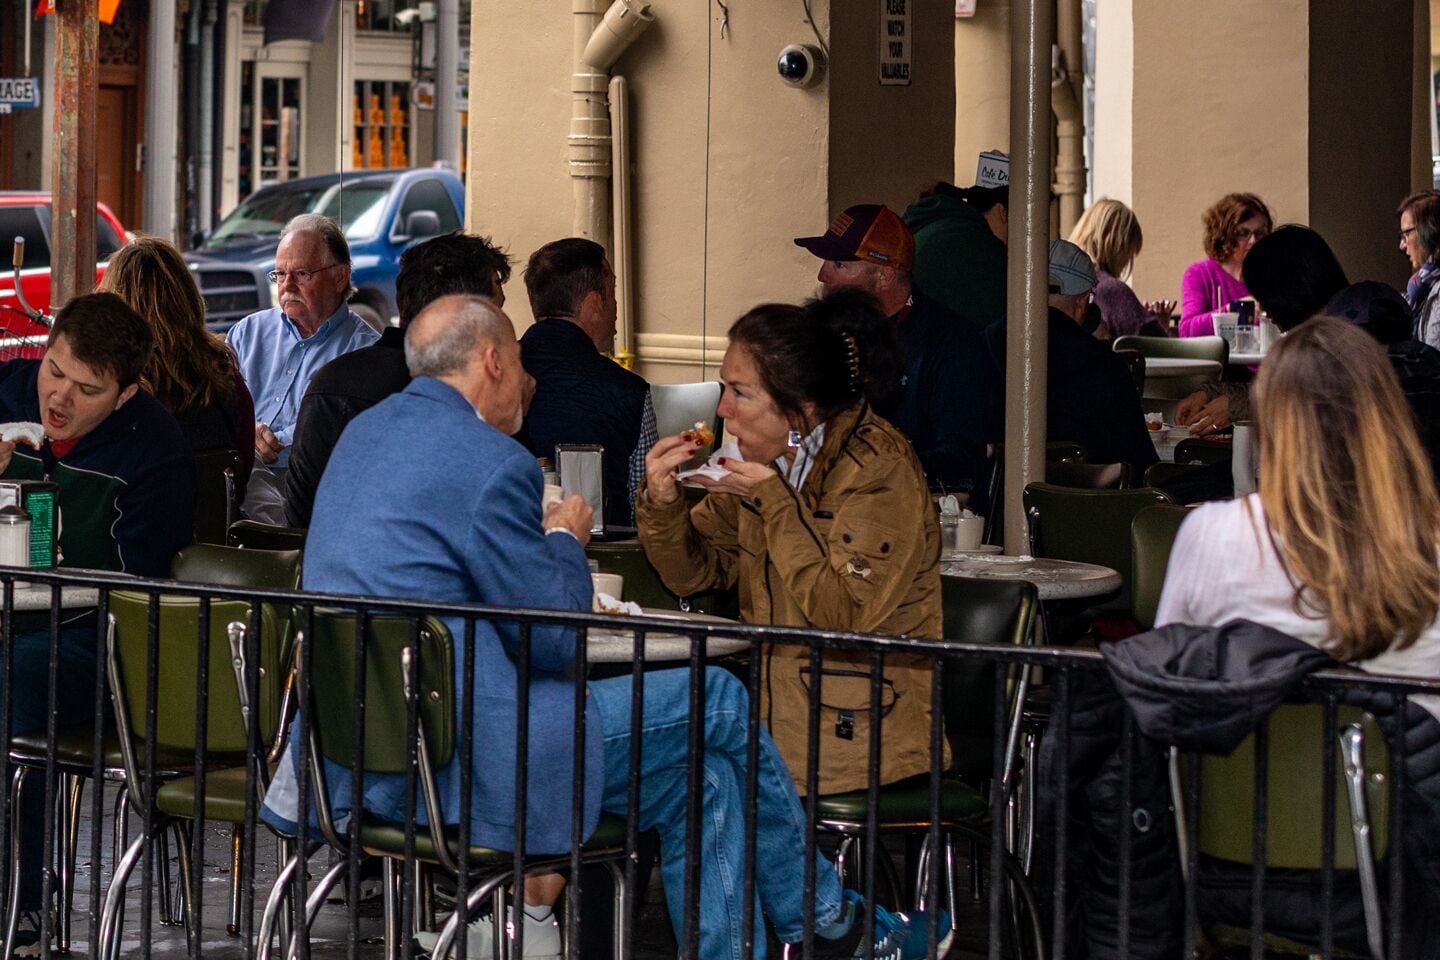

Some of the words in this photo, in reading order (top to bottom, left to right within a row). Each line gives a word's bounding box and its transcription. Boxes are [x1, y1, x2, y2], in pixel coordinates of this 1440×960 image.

[887, 20, 905, 36] WATCH
[888, 41, 903, 58] YOUR
[881, 62, 909, 79] VALUABLES
